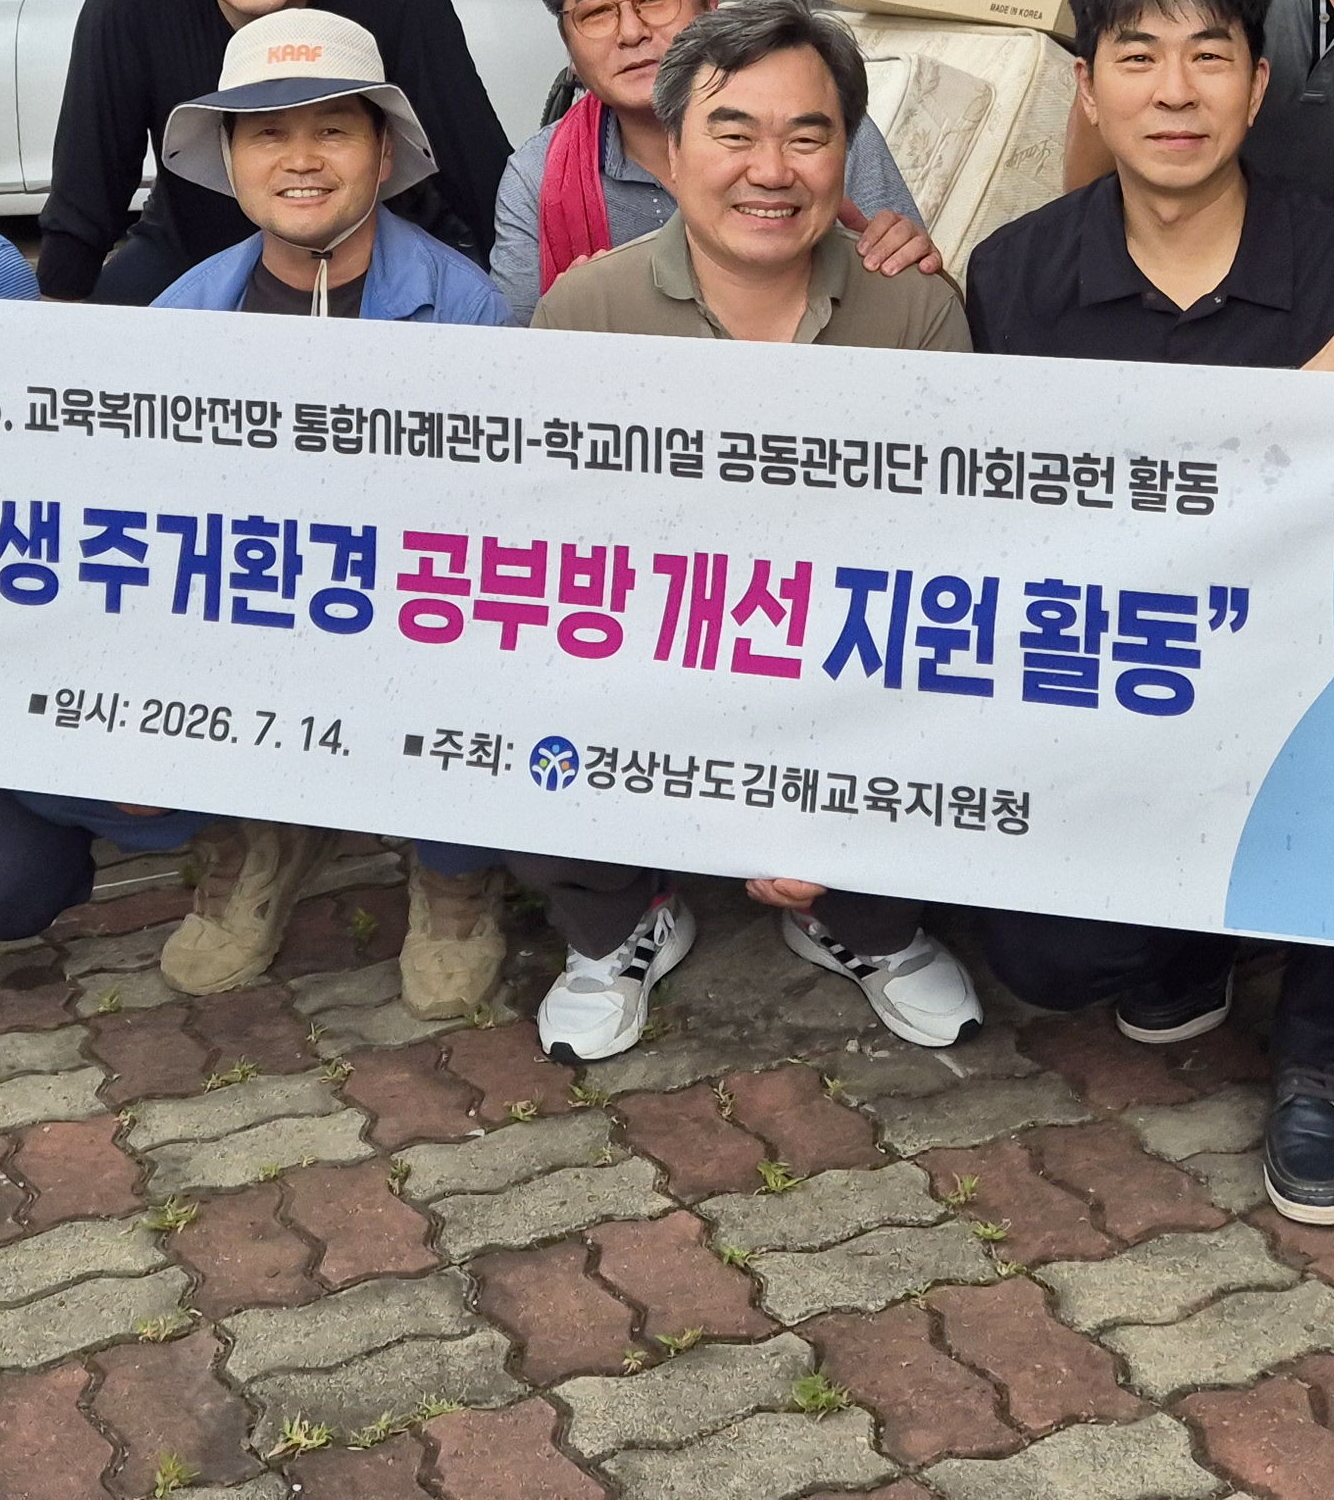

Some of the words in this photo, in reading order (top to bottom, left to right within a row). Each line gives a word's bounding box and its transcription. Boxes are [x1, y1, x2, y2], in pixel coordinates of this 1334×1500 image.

[989, 3, 1009, 15] MADE
[1010, 6, 1018, 16] IN
[1018, 8, 1043, 20] KOREA
[267, 44, 323, 64] KAAF
[24, 385, 283, 450] 교육복지안전망
[292, 402, 705, 480] 통합사례관리-학교시설
[717, 431, 929, 497] 공동관리단
[938, 444, 1116, 510] 사회공헌
[1127, 455, 1219, 516] 활동
[78, 507, 378, 636] 주거환경
[396, 530, 636, 660] 공부방
[652, 551, 814, 682] 개선
[821, 566, 1000, 698] 지원
[138, 698, 239, 745] 2026.
[254, 710, 286, 749] 7.
[301, 716, 351, 758] 14.
[583, 745, 1032, 837] 경상남도김해교육지원청
